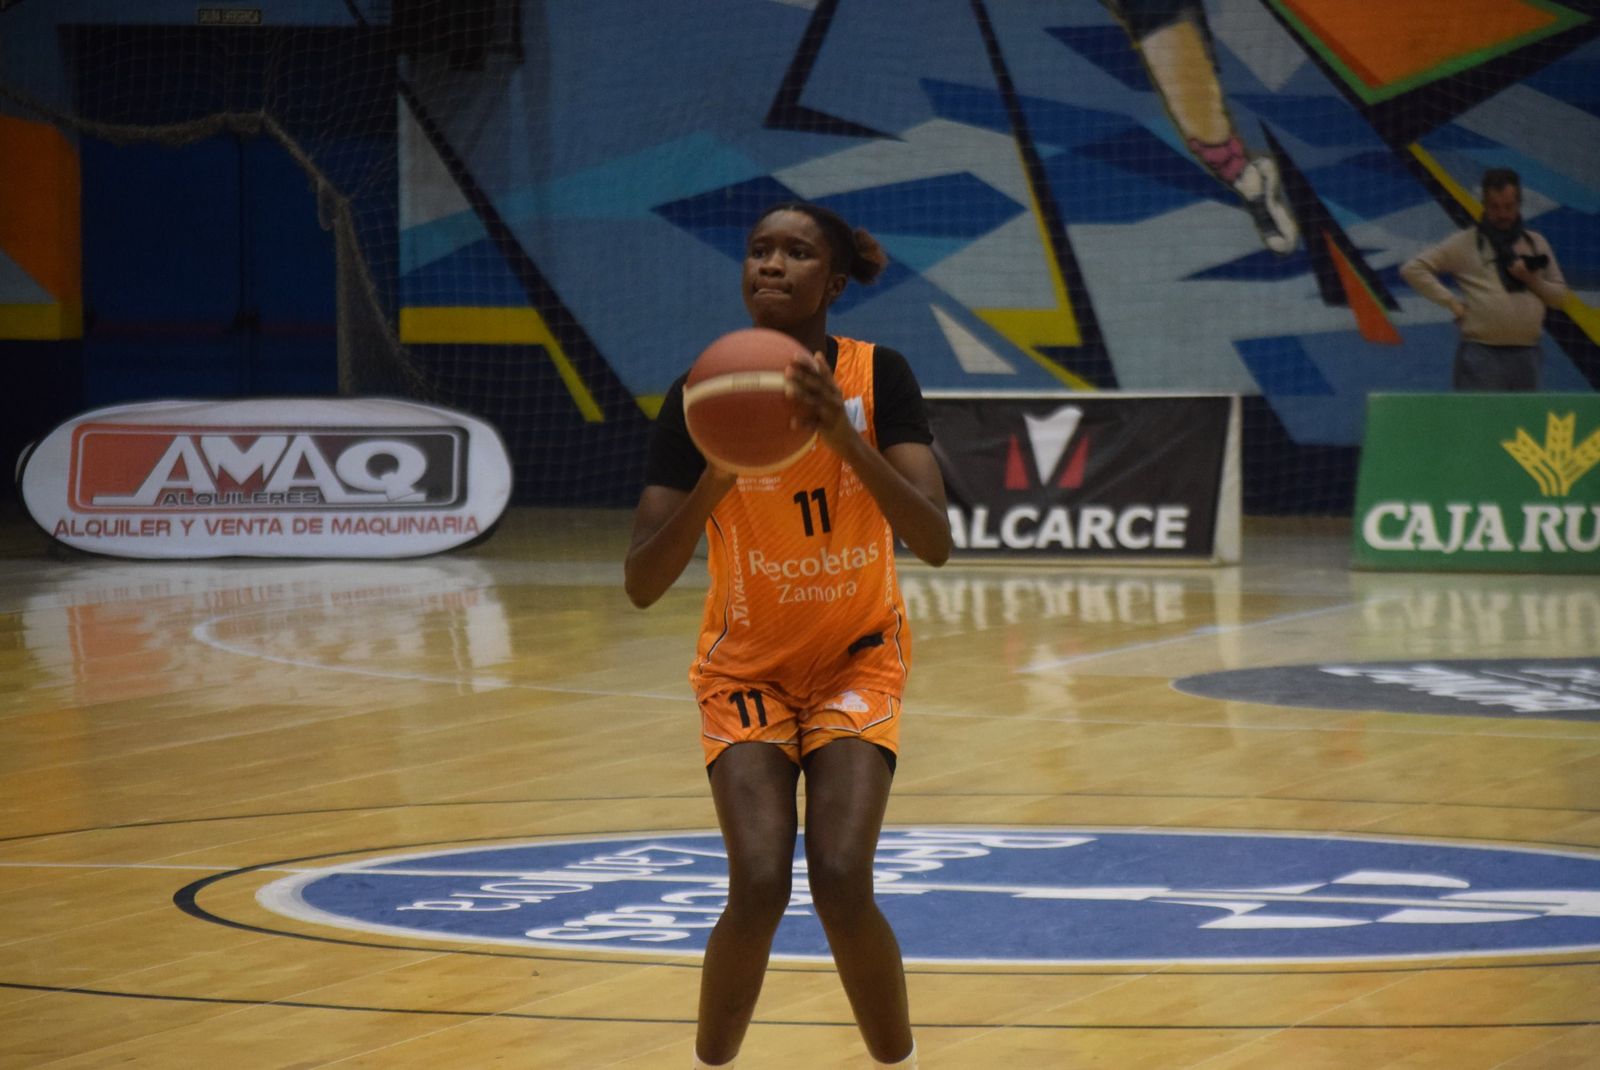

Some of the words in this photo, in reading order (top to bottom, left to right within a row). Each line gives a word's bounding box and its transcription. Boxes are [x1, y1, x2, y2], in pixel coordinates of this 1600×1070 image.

[93, 433, 427, 505] AMAQ
[161, 491, 320, 506] ALQUILERES
[793, 487, 831, 536] 11
[53, 518, 171, 538] ALQUILER
[181, 519, 196, 537] Y
[204, 518, 283, 536] VENTA
[292, 517, 324, 535] DE
[331, 516, 480, 536] MAQUINARIA
[1362, 503, 1514, 554] CAJA
[747, 541, 880, 581] Recoletas
[776, 580, 857, 604] Zamora
[729, 689, 769, 729] 11
